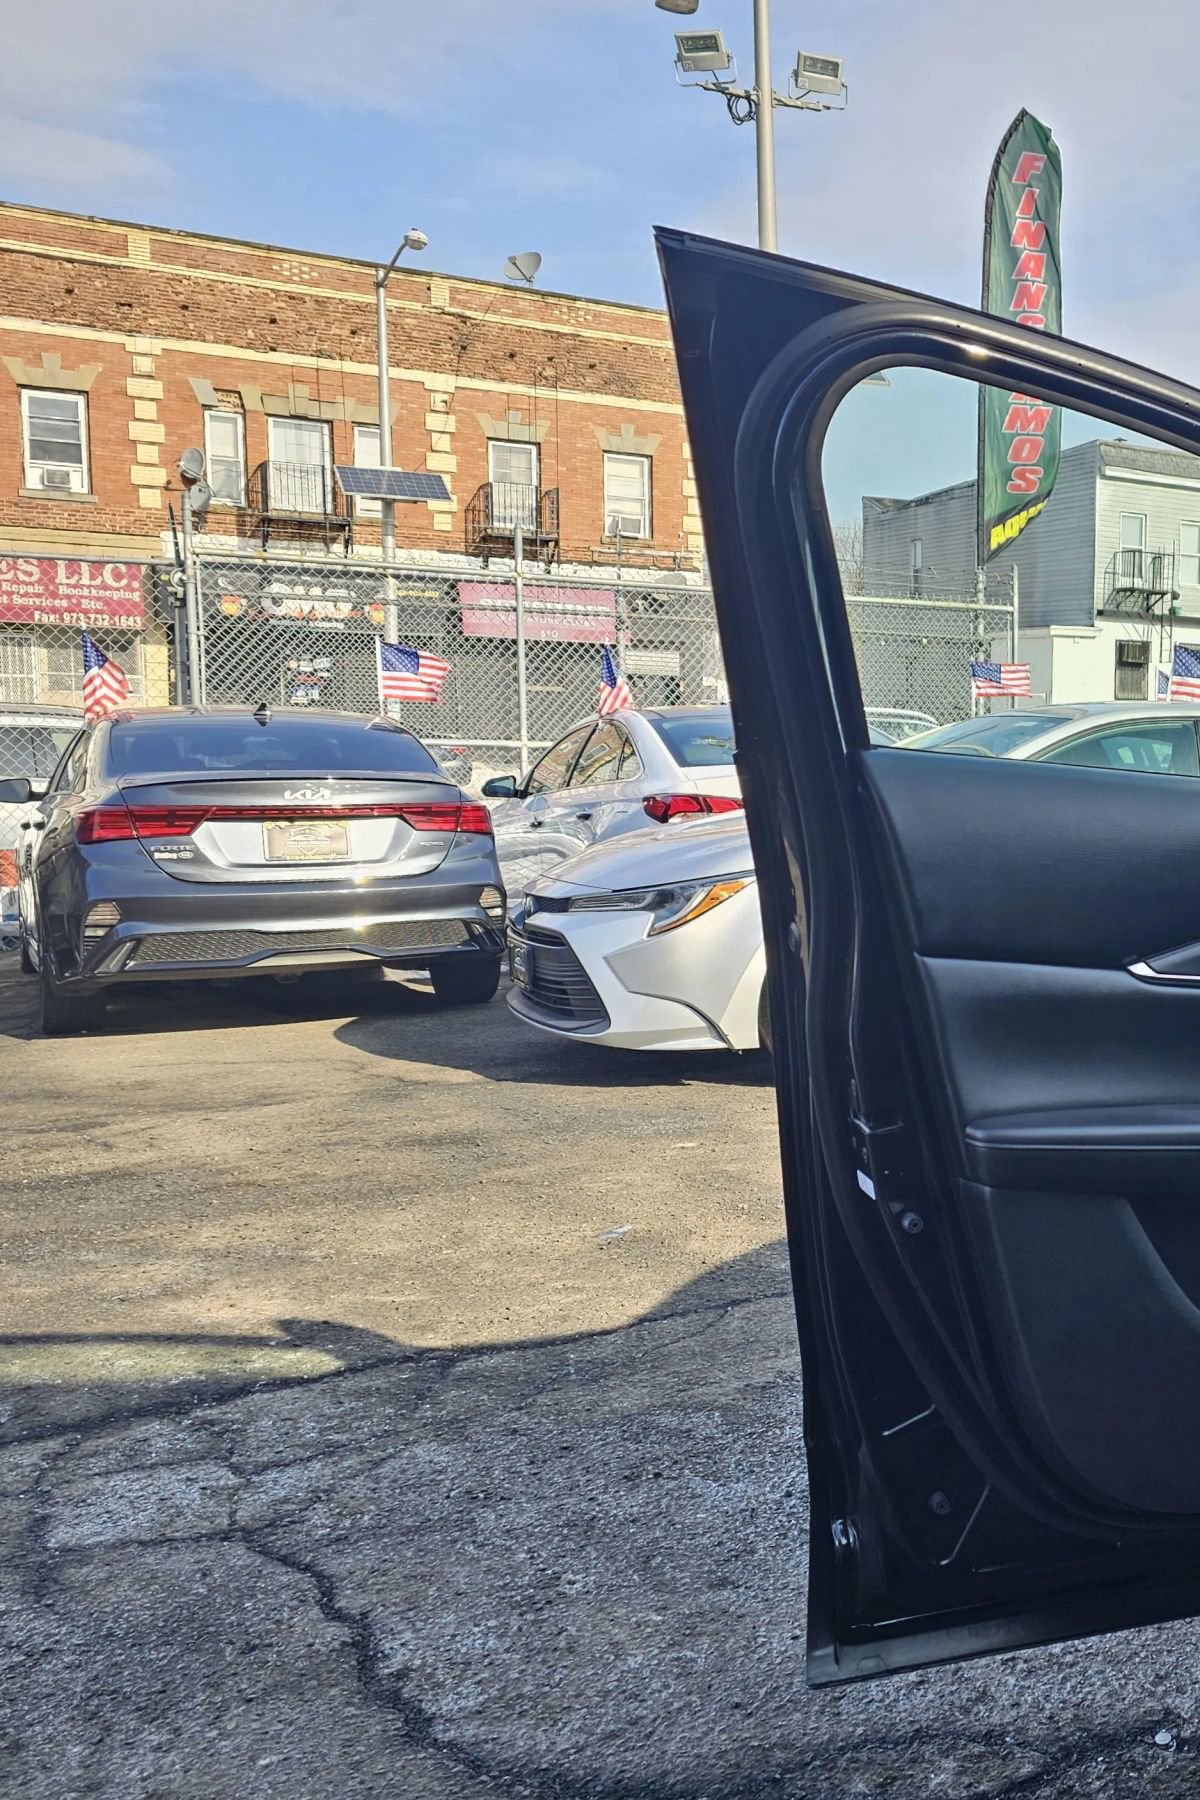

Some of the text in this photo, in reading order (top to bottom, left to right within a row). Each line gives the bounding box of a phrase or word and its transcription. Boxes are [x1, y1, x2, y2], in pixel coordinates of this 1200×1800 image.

[2, 581, 141, 602] Repair Bookkeeping
[12, 594, 69, 608] Services
[33, 610, 60, 623] Fax:
[284, 787, 331, 800] KIA
